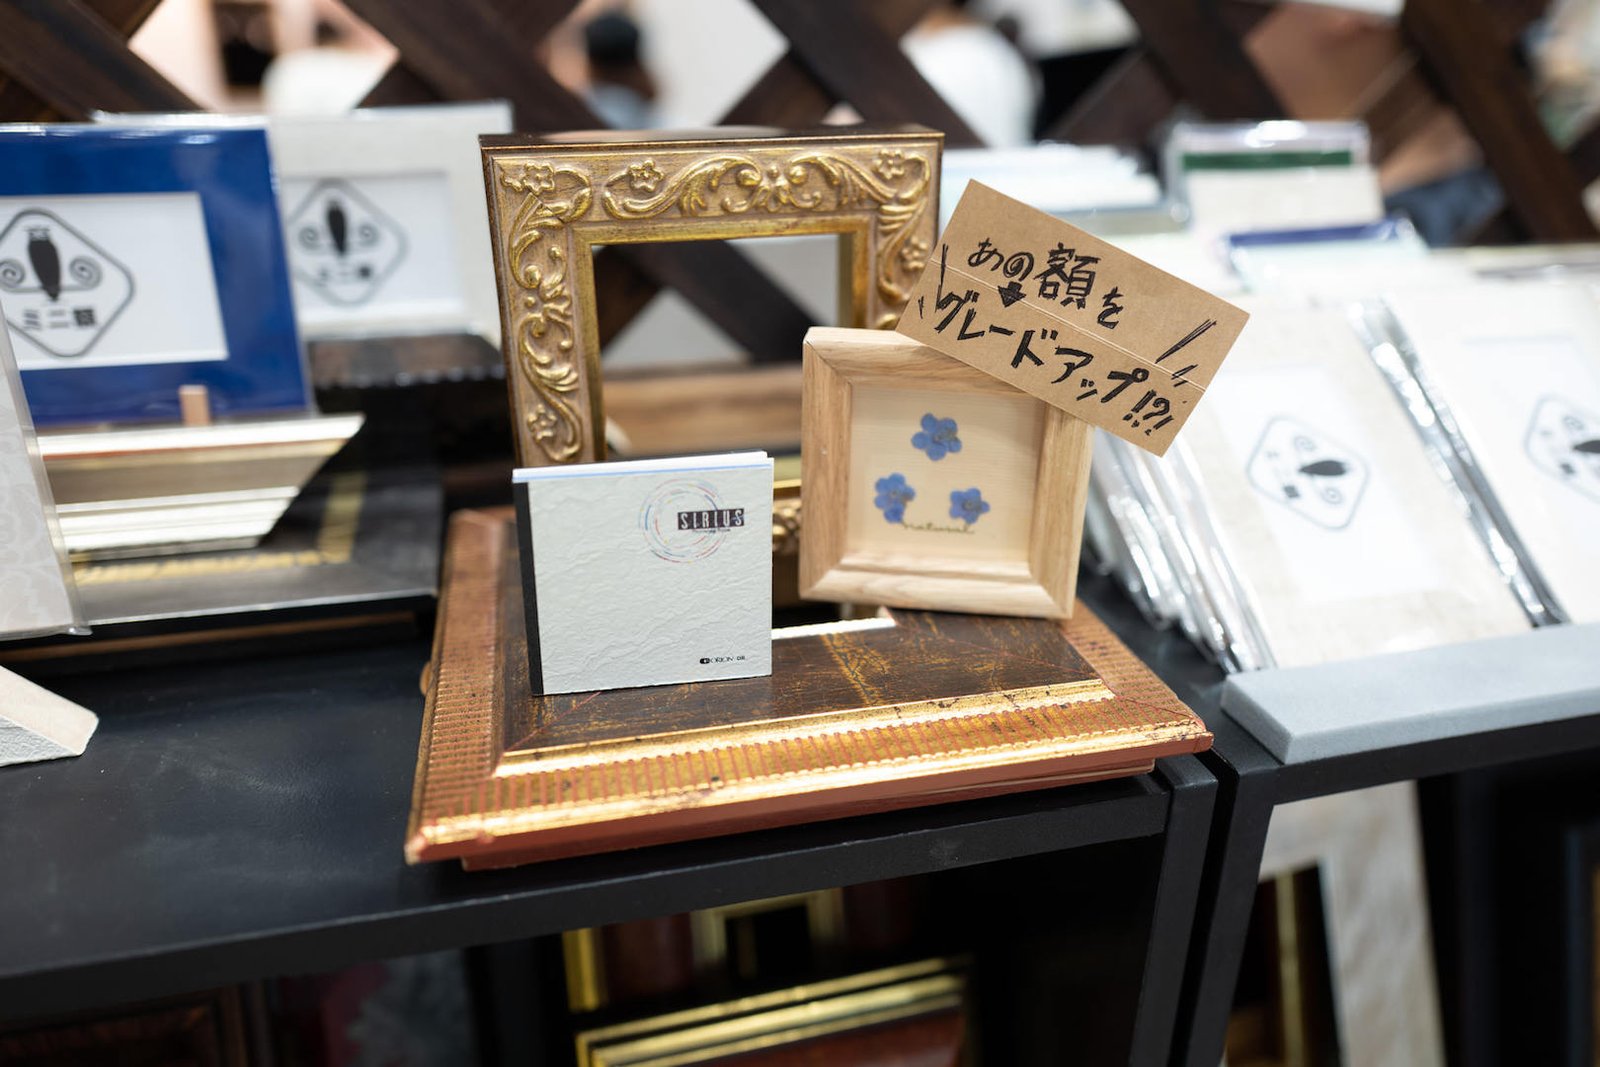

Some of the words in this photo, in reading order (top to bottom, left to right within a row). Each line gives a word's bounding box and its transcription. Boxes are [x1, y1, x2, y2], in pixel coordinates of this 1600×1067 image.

[968, 237, 1124, 330] あの額を
[679, 509, 744, 530] SIRIUS
